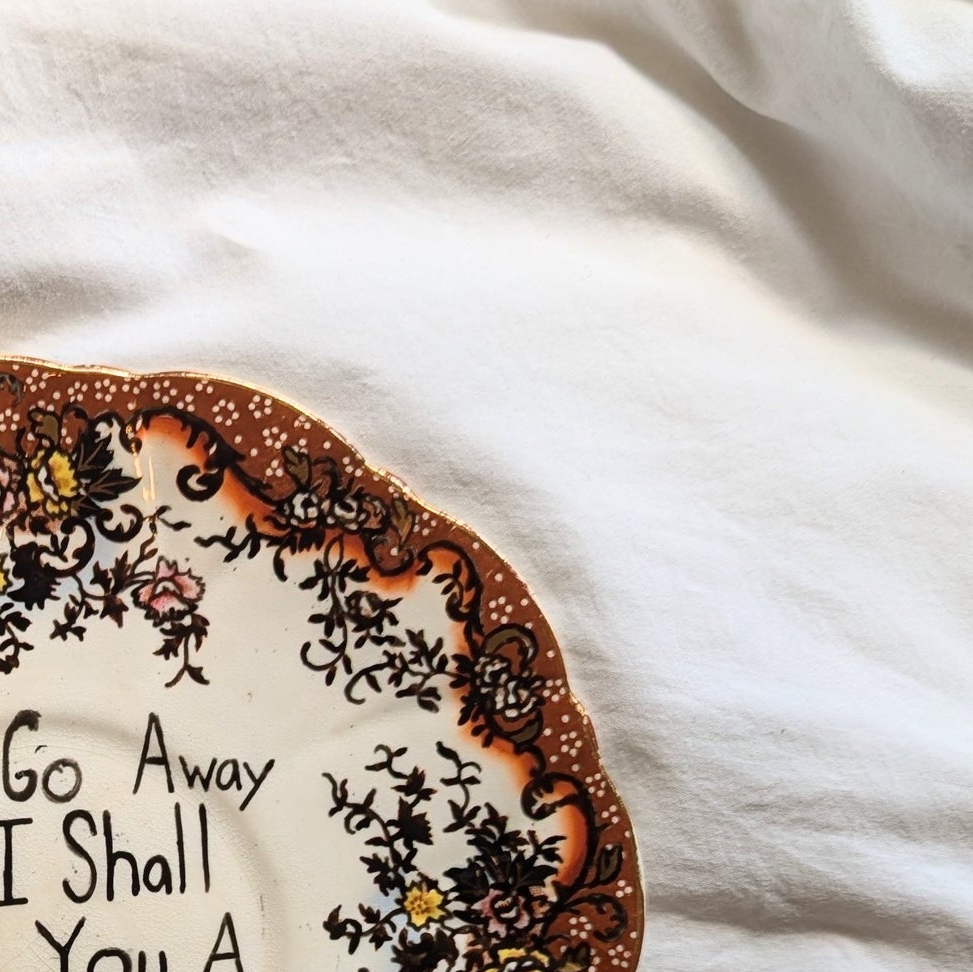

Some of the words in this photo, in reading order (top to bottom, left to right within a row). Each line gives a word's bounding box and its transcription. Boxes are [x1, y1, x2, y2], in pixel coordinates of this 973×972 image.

[2, 709, 82, 804] Go
[132, 712, 276, 812] Away
[62, 802, 211, 904] Shall
